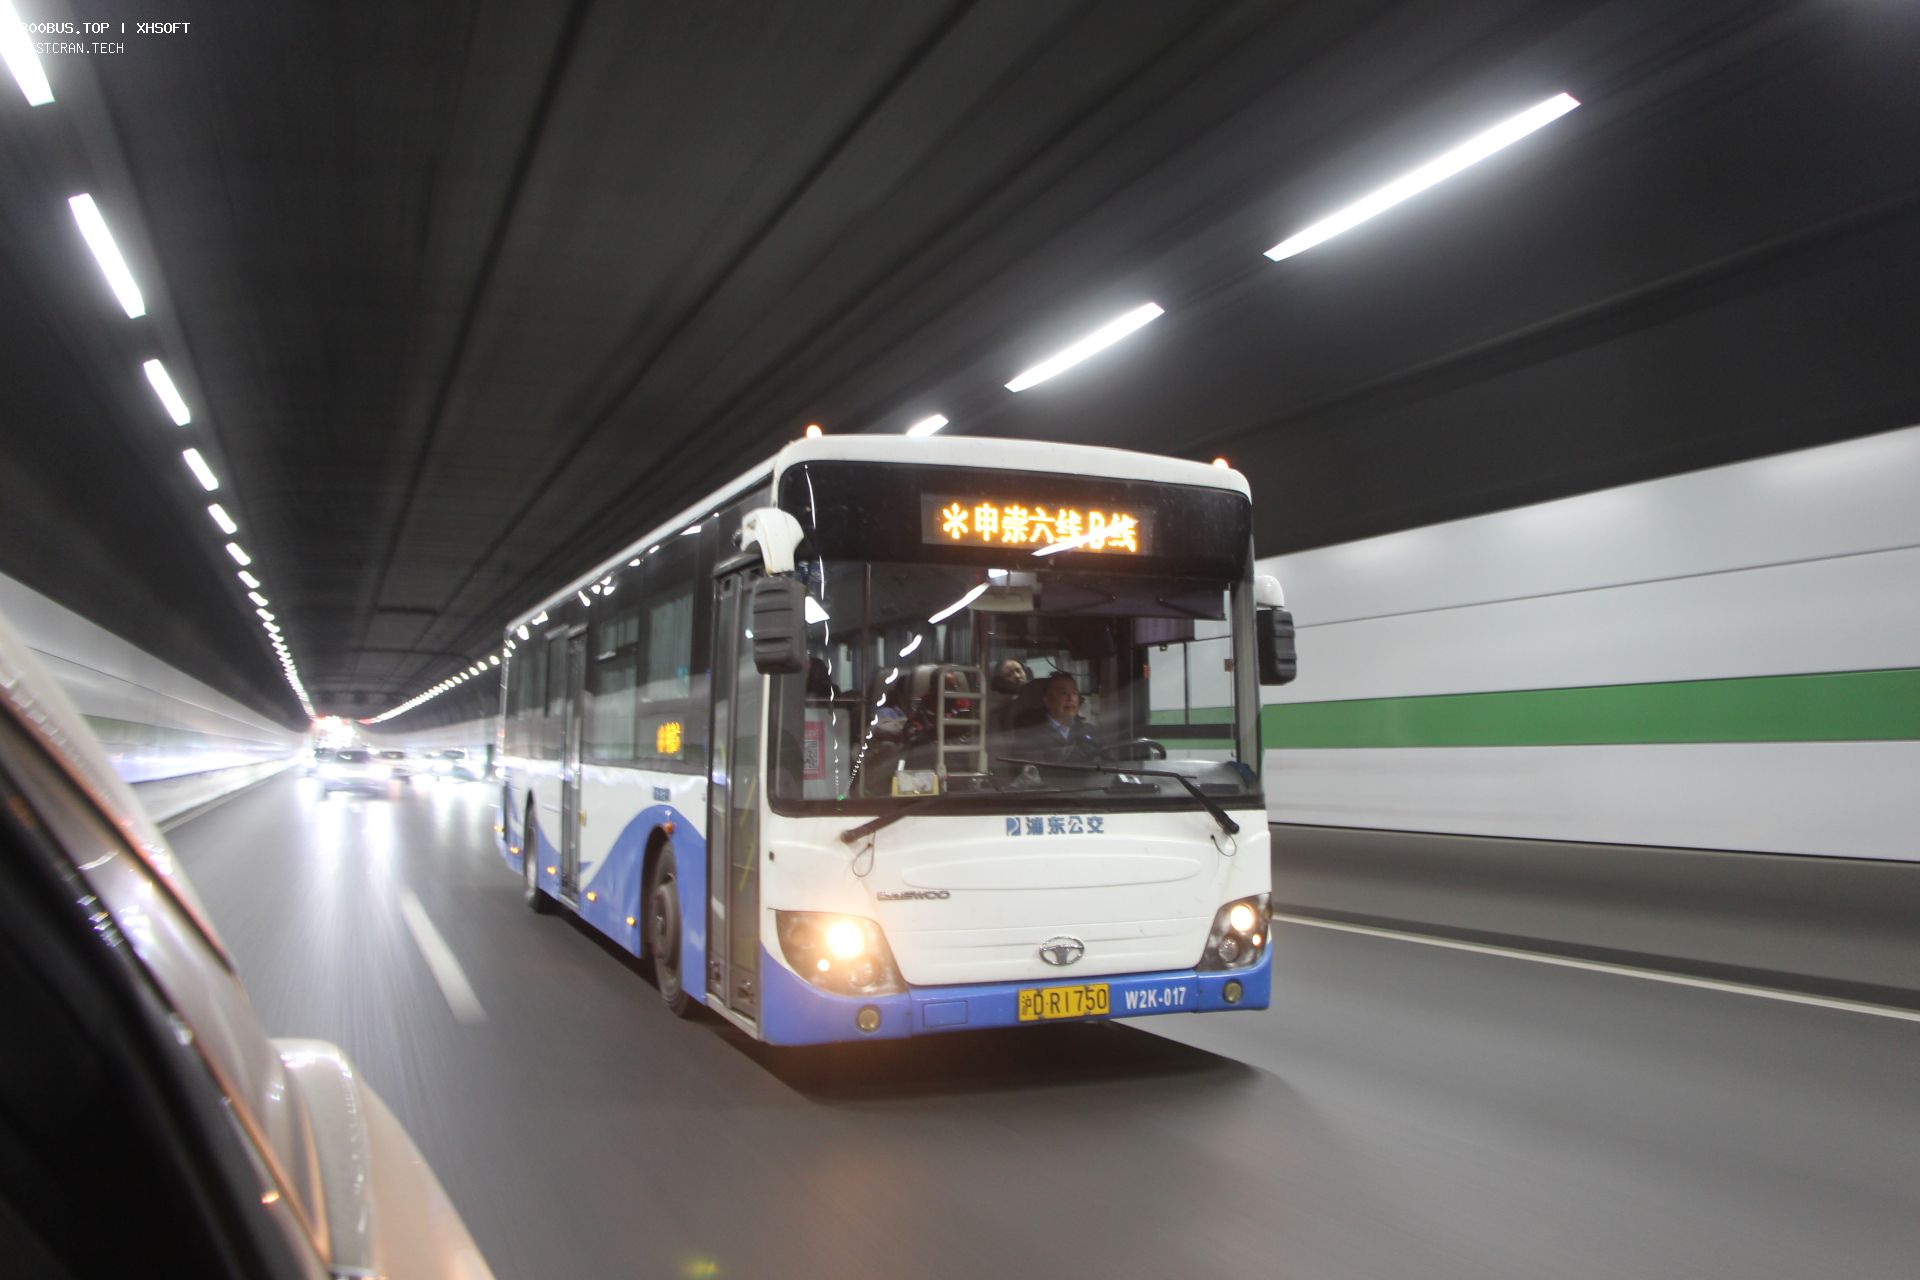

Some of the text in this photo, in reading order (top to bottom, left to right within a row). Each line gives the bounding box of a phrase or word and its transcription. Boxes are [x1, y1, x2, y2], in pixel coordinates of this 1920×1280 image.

[1026, 816, 1104, 835] 浦东公交
[1125, 987, 1187, 1010] W2K-017
